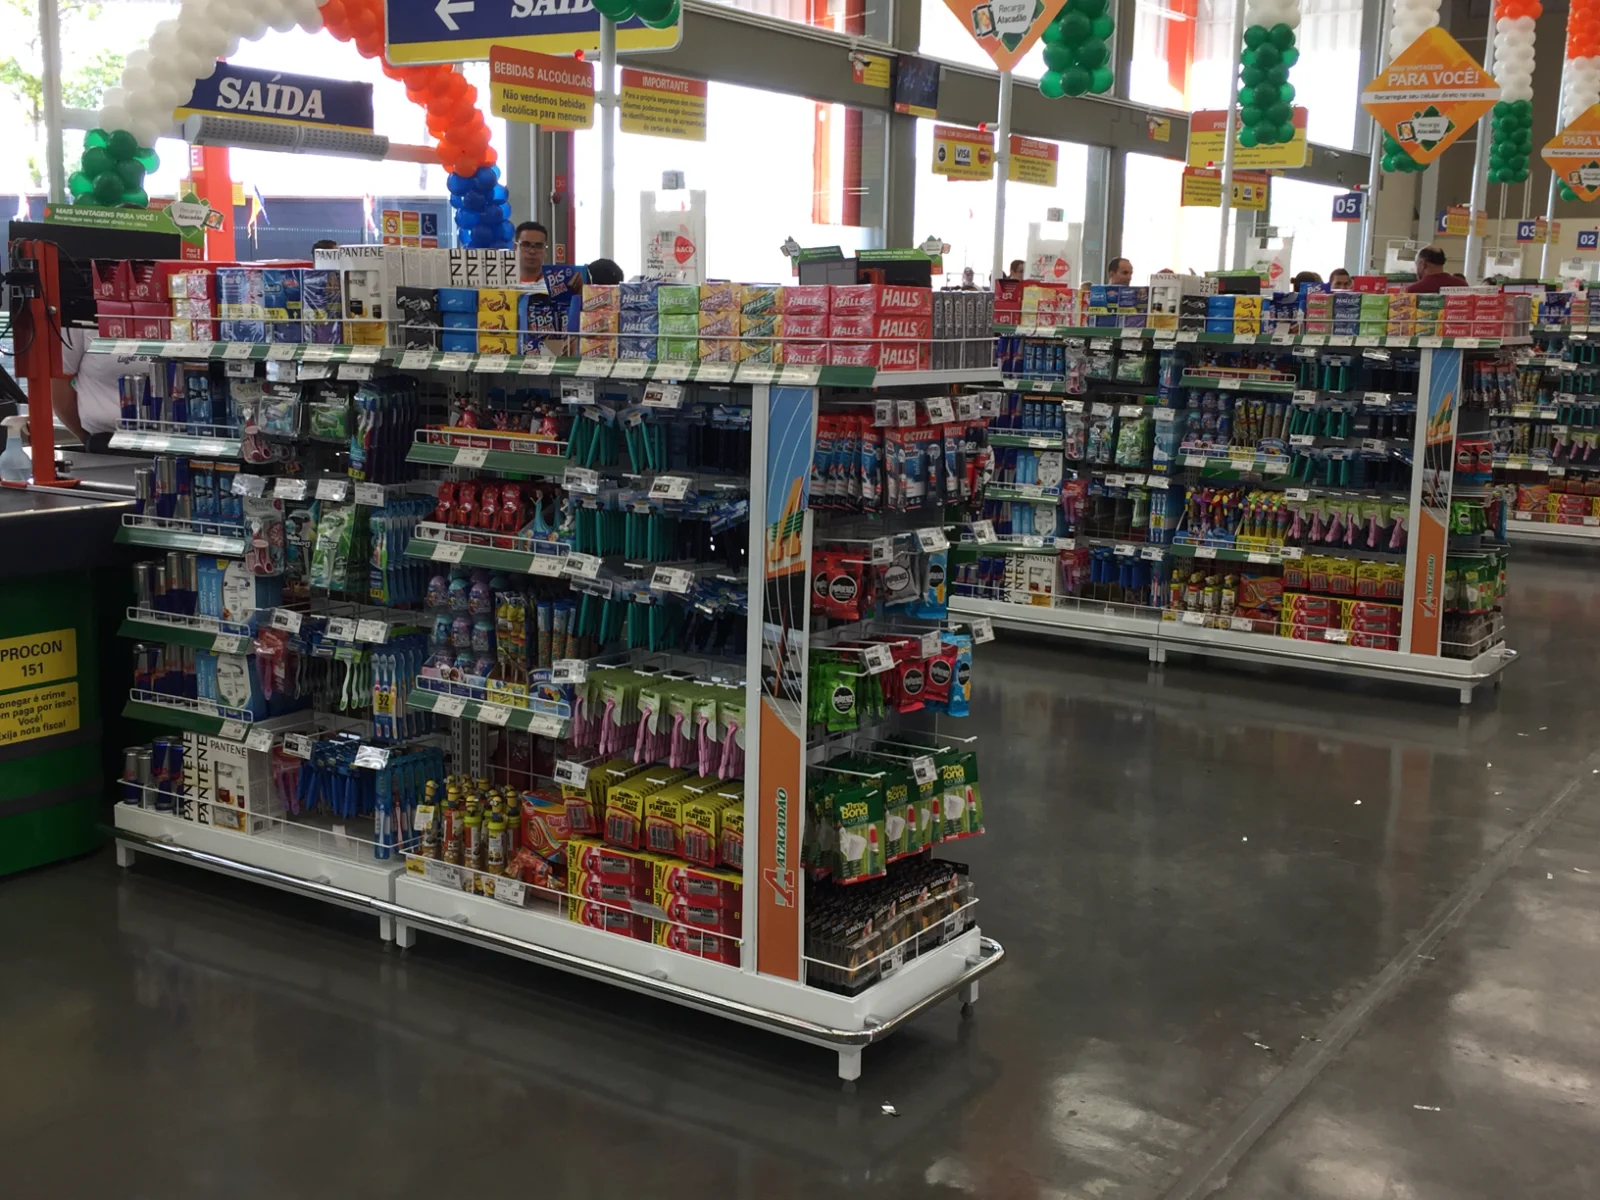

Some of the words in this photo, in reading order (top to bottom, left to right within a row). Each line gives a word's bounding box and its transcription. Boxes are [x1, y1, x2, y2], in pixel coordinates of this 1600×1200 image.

[494, 61, 534, 80] BEBIDAS
[536, 68, 593, 88] ALCOÓLICAS
[1387, 72, 1429, 87] PARA
[1433, 67, 1480, 85] VOCÊ!
[642, 76, 689, 93] IMPORTANTE
[216, 74, 325, 120] SAÍDA
[502, 88, 519, 101] Não
[520, 92, 558, 106] vendemos
[559, 98, 586, 111] bebidas
[1420, 92, 1440, 100] celular
[501, 104, 538, 117] alcoólicas
[539, 109, 555, 121] para
[556, 112, 587, 124] menores
[956, 149, 970, 159] VISA
[1335, 198, 1357, 214] 05
[56, 207, 74, 216] MAIS
[74, 208, 115, 219] VANTAGENS
[115, 211, 135, 220] PARA
[1580, 234, 1596, 245] 02
[340, 246, 384, 257] PANTENE
[622, 293, 649, 303] HALLS
[661, 296, 689, 305] HALLS
[788, 296, 817, 306] HALLS
[835, 296, 866, 307] HALLS
[881, 289, 919, 306] HALLS
[743, 297, 765, 313] HALLS
[622, 322, 650, 332] HALLS
[787, 326, 816, 336] HALLS
[833, 326, 862, 336] HALLS
[879, 319, 917, 338] HALLS
[621, 350, 648, 360] HALLS
[787, 354, 816, 364] HALLS
[832, 355, 862, 365] HALLS
[880, 348, 915, 365] HALLS
[1027, 554, 1056, 565] PANTENE
[0, 640, 62, 662] PROCON
[21, 662, 44, 677] 151
[0, 695, 31, 709] onegar
[41, 690, 66, 702] crime
[12, 706, 35, 720] paga
[41, 703, 53, 714] por
[54, 696, 77, 710] isso?
[18, 714, 44, 727] Você!
[20, 727, 41, 737] nota
[42, 719, 66, 732] fiscal
[210, 739, 247, 757] PANTENE
[183, 731, 194, 821] PANTENE
[197, 734, 210, 825] PANTENE
[626, 798, 639, 807] LUX
[664, 805, 677, 814] LUX
[699, 814, 711, 824] LUX
[841, 806, 868, 820] Bond
[845, 921, 866, 937] DURACELL
